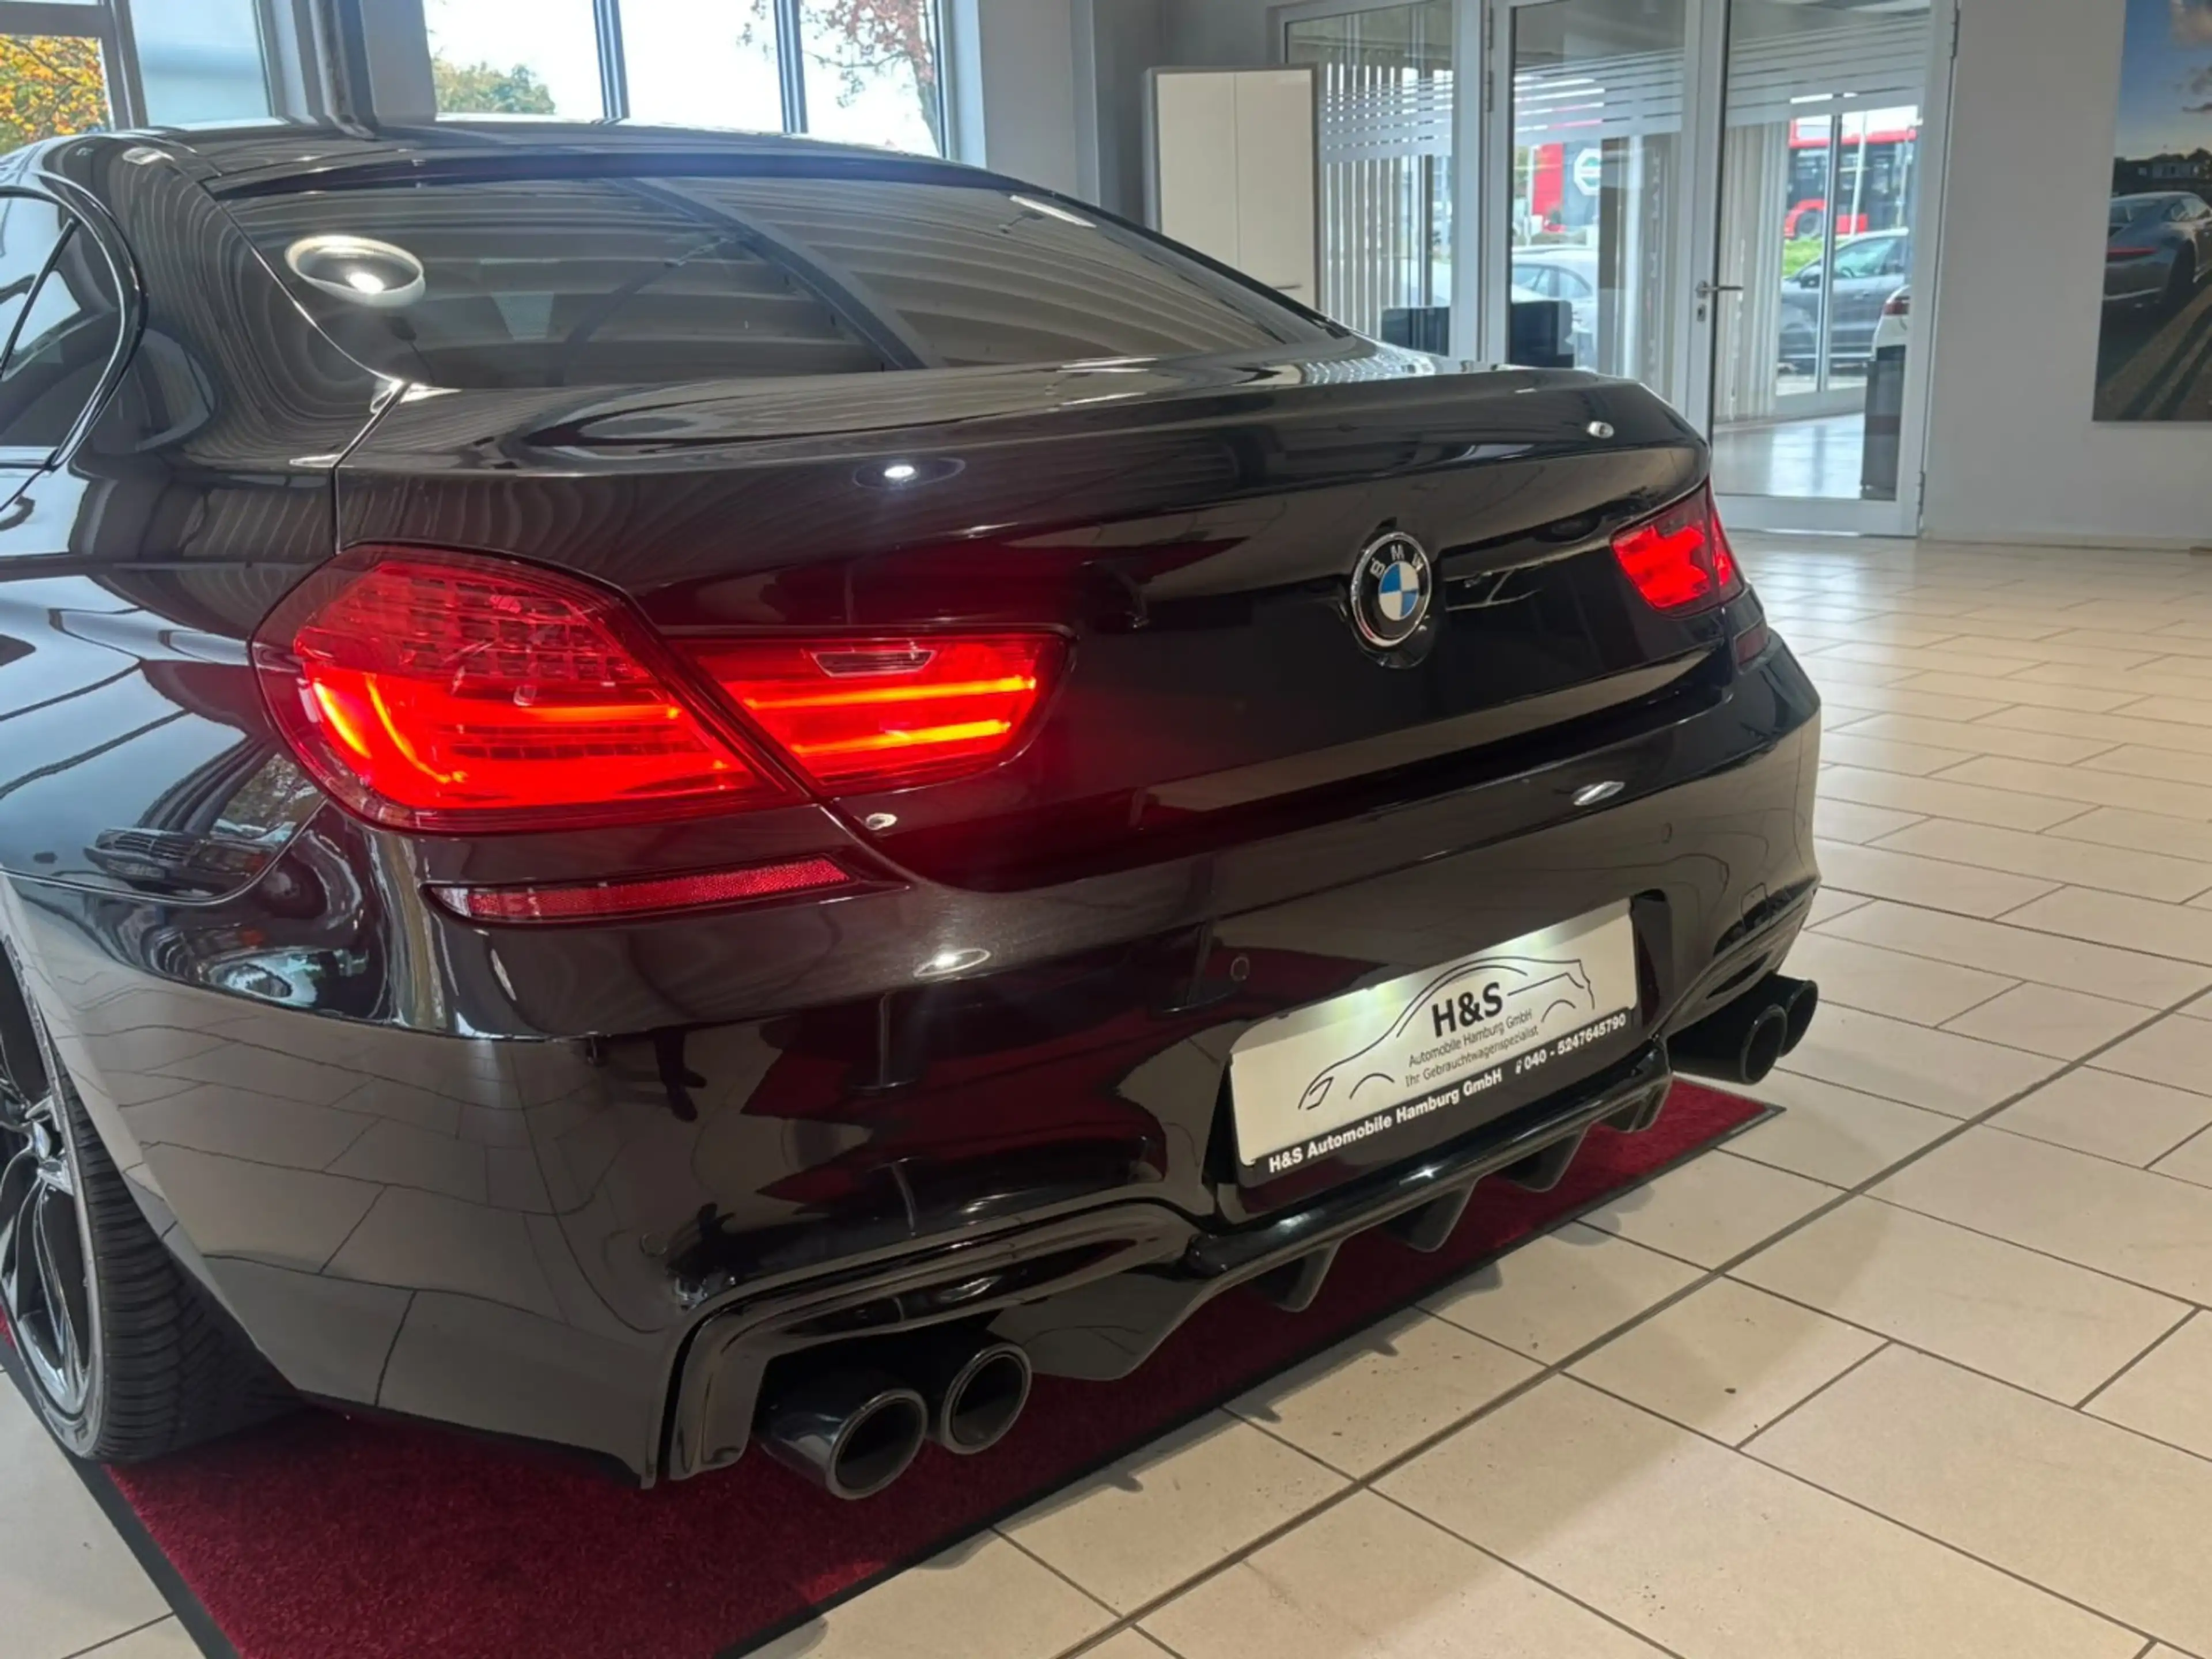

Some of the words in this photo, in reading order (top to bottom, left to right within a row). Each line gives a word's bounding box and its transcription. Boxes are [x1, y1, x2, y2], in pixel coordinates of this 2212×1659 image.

[1370, 544, 1423, 578] BMW
[1408, 1039, 1461, 1067] Automobile
[1464, 1021, 1505, 1046] Hamburg
[1506, 1009, 1532, 1029] GmbH
[1431, 982, 1503, 1038] H&S
[1406, 1074, 1421, 1088] Ihr
[1422, 1025, 1539, 1081] Gebrauchtwagenspezialist
[1268, 1147, 1303, 1173] H&S
[1307, 1115, 1392, 1159] Automobile
[1396, 1089, 1460, 1124] Hamburg
[1463, 1068, 1502, 1096] GmbH
[1524, 1048, 1547, 1070] 040
[1557, 1012, 1626, 1055] 5247645790
